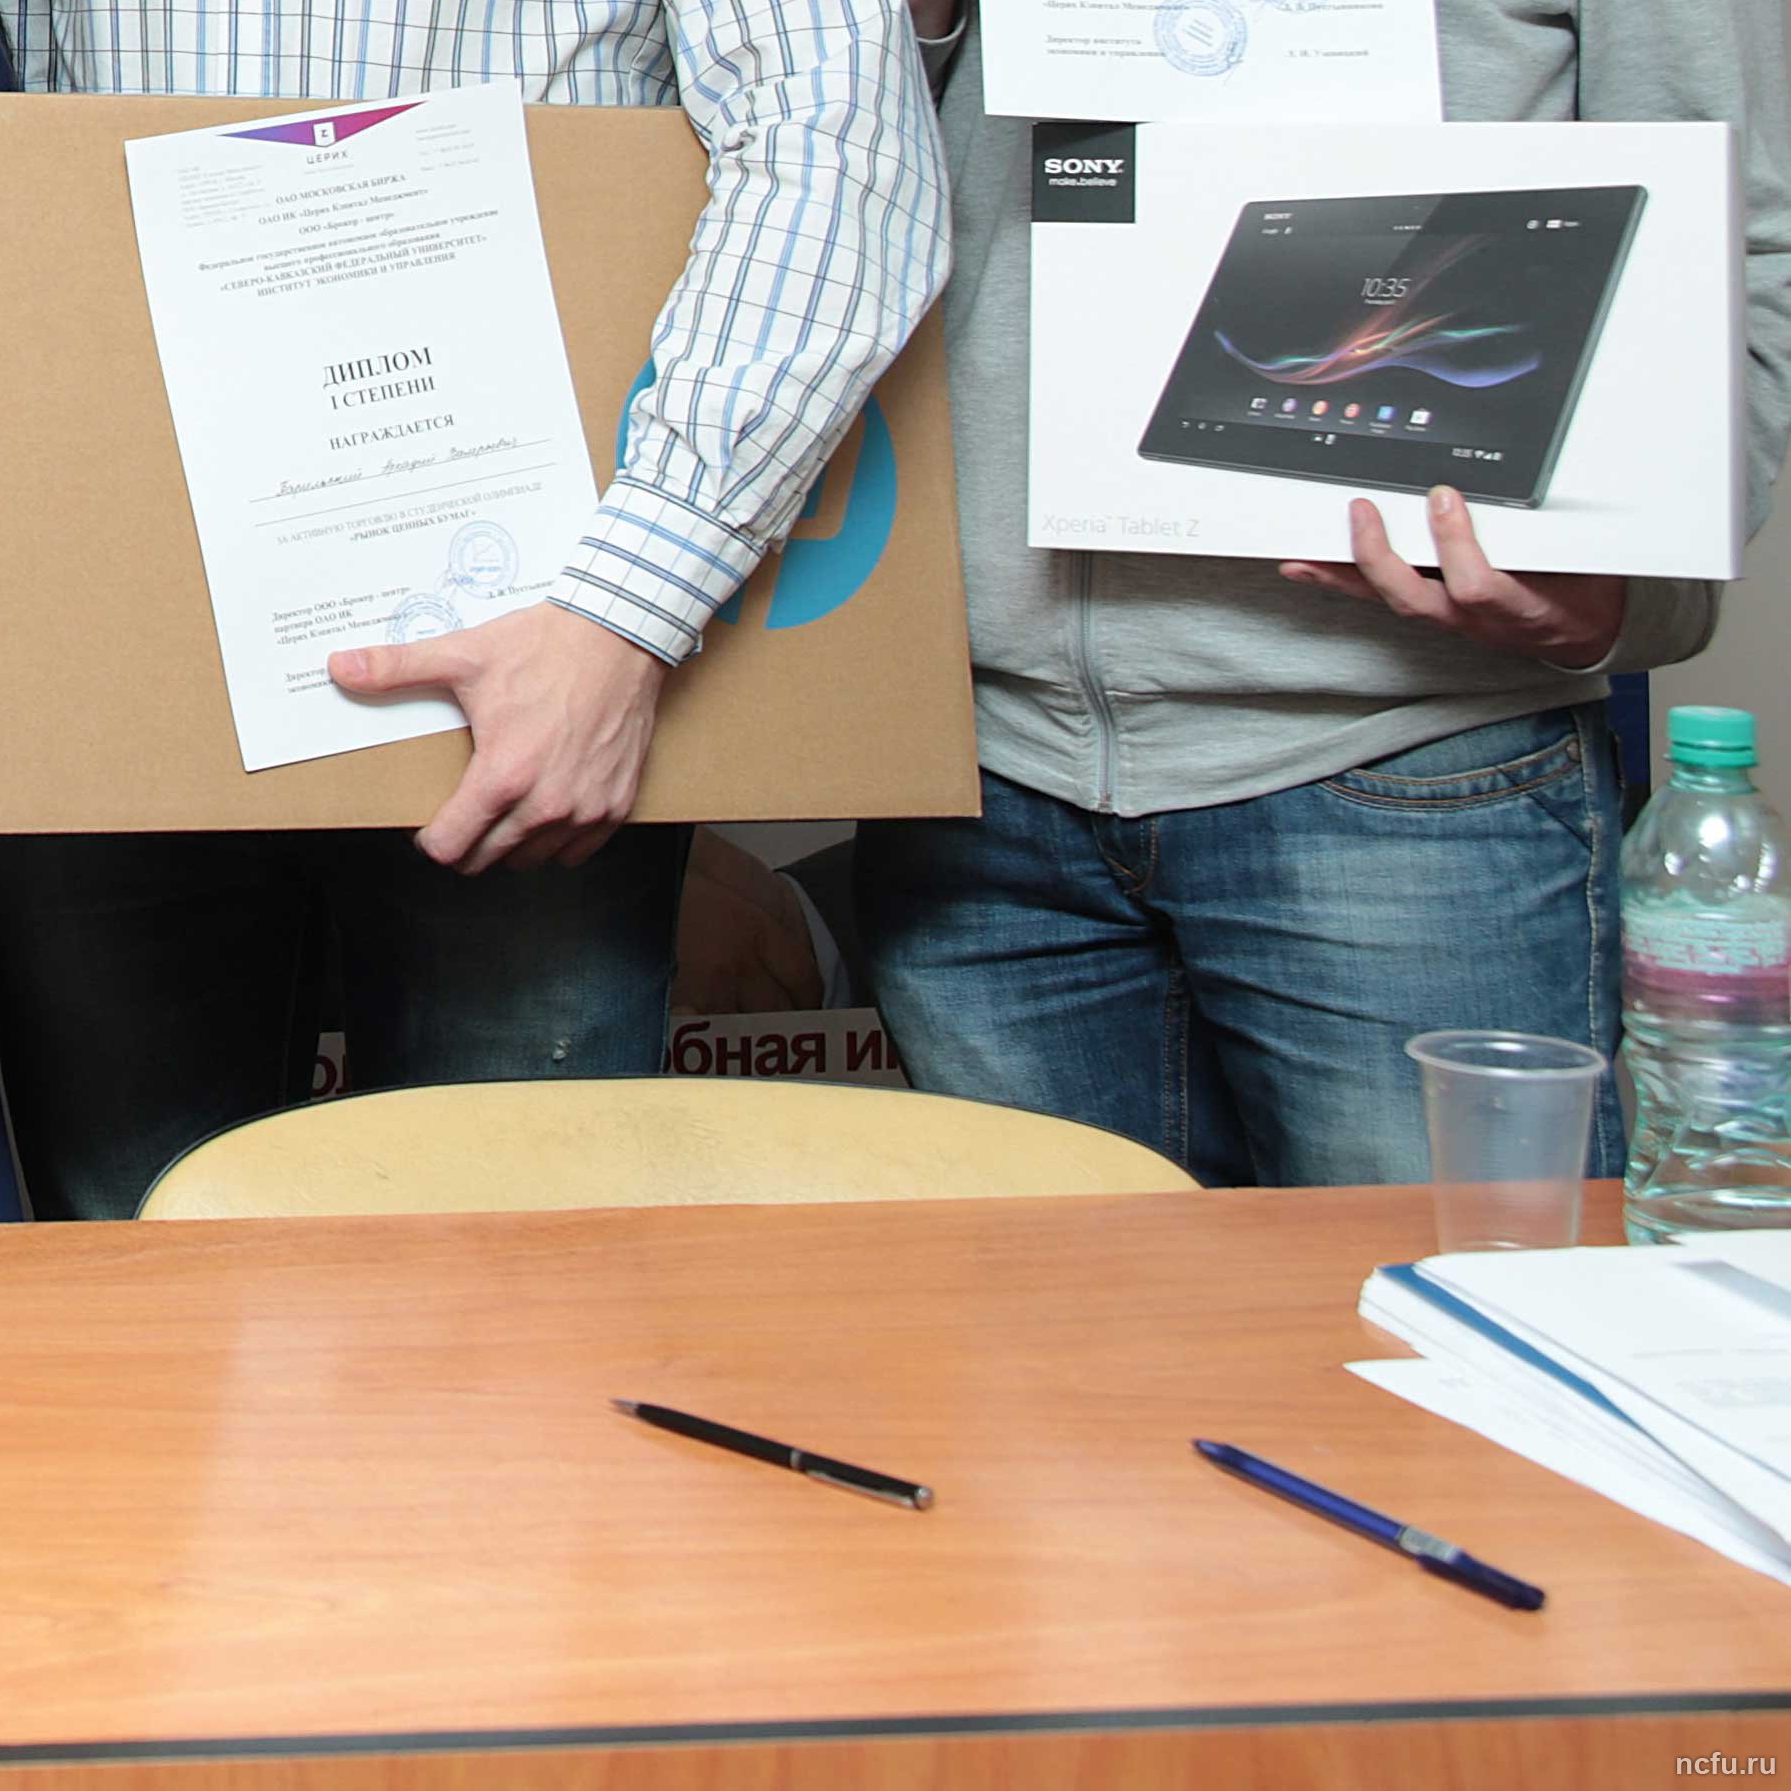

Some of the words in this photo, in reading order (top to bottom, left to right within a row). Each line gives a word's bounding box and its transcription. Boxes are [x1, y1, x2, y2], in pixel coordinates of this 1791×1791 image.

[306, 150, 349, 165] ЦЕРИХ
[1044, 158, 1125, 174] SONY
[300, 180, 369, 200] МОСКОВСКАЯ
[1360, 277, 1412, 299] 10:35
[322, 346, 433, 389] ДИПЛОМ
[342, 375, 436, 409] СТЕПЕНИ
[328, 413, 456, 451] НАГРАЖДАЕТСЯ
[1117, 516, 1182, 537] Tablet
[1185, 519, 1201, 538] Z
